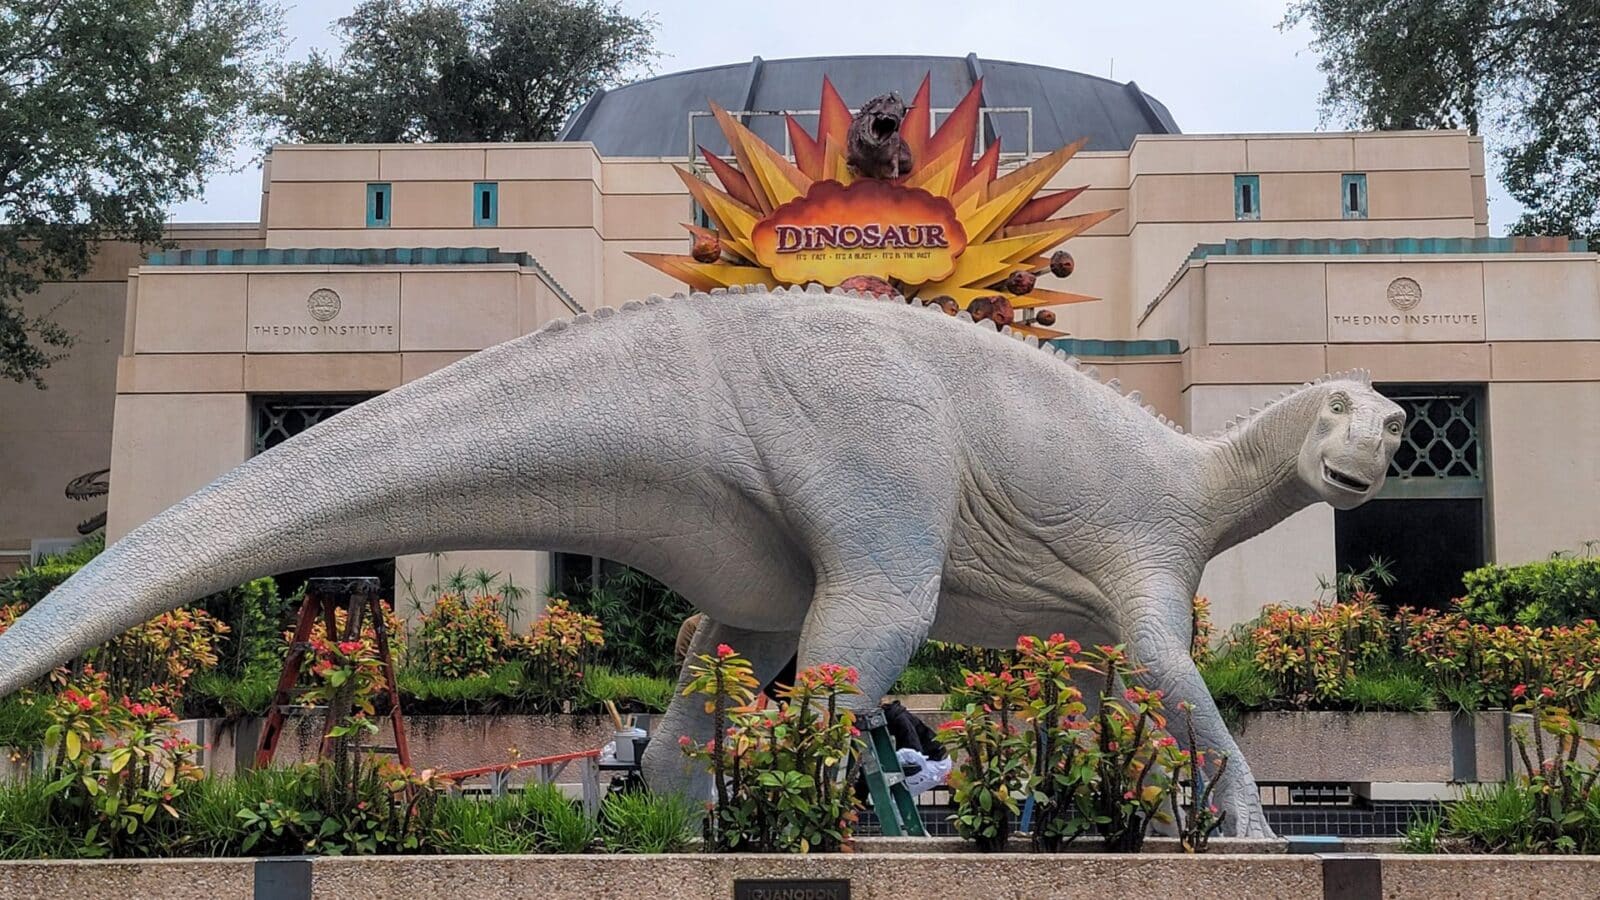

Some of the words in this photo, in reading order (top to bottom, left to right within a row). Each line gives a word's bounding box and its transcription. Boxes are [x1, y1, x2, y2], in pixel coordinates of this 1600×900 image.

[775, 224, 949, 253] DINOSAUR
[1334, 315, 1360, 325] THE
[1363, 315, 1401, 325] DINO
[1405, 314, 1478, 325] INSTITUTE
[253, 326, 279, 336] THE
[282, 326, 319, 336] DINO
[323, 325, 393, 336] INSTITUTE
[747, 888, 840, 900] IGUANODON
